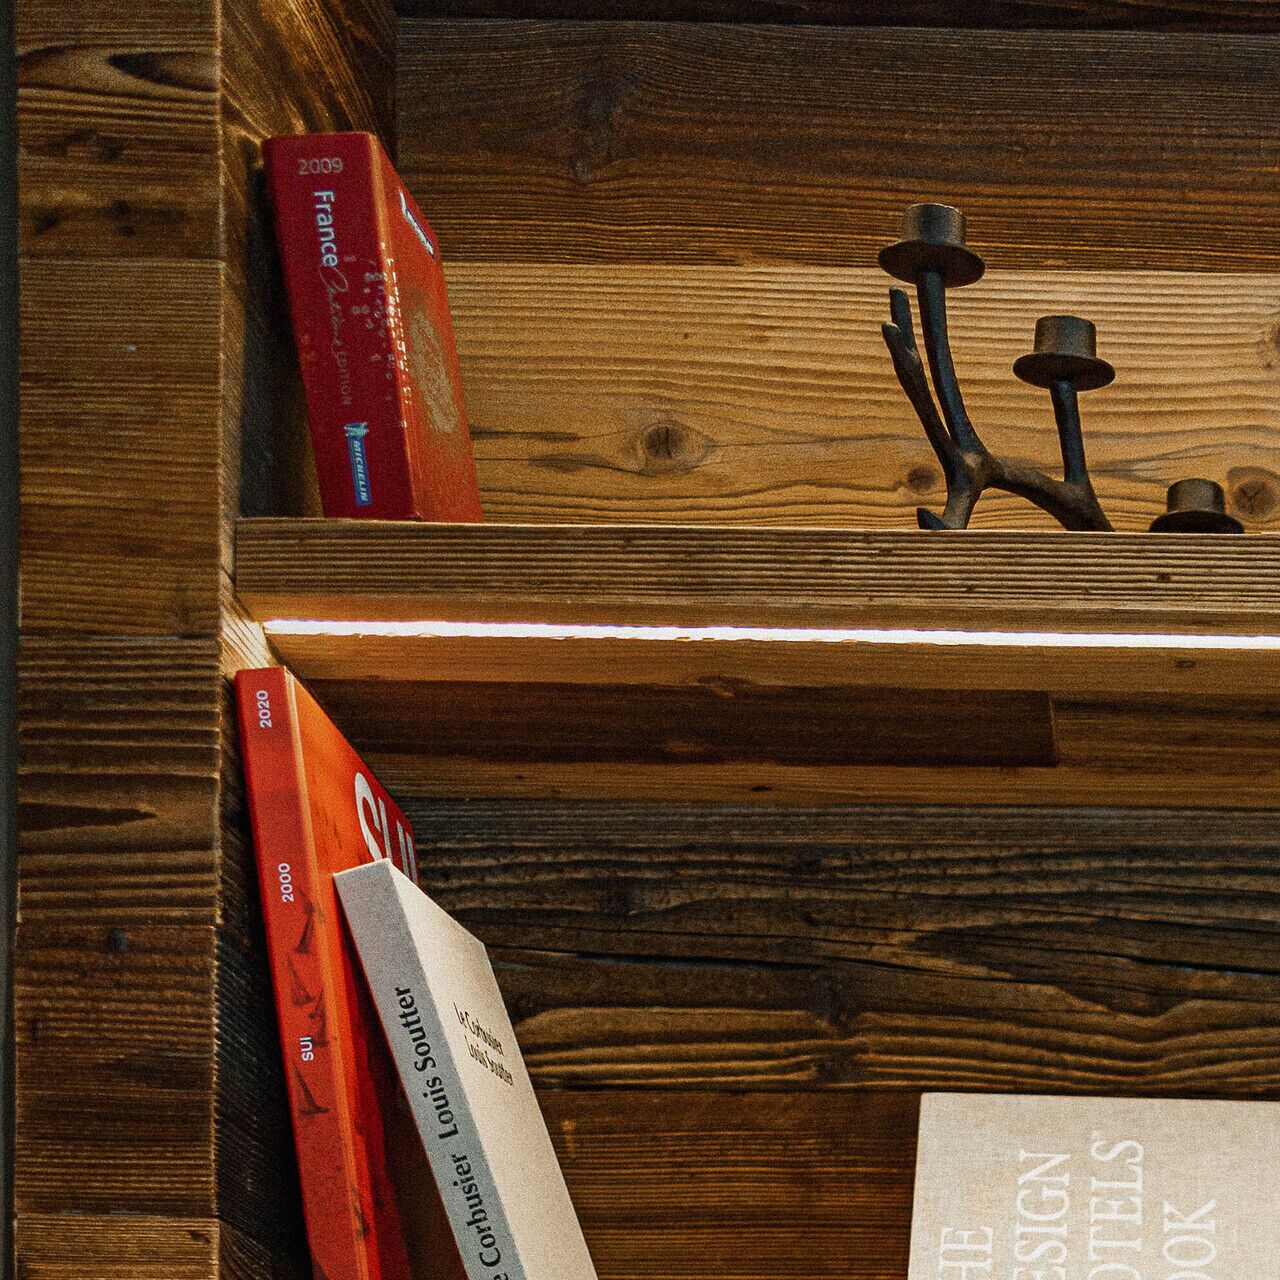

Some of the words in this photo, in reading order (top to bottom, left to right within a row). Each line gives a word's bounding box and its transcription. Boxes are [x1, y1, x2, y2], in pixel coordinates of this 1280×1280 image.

[298, 157, 343, 174] 2009
[313, 190, 338, 267] France
[256, 689, 272, 729] 2020
[277, 862, 294, 903] 2000
[300, 1036, 314, 1061] SUI
[394, 986, 437, 1073] Soutter
[454, 1002, 467, 1029] Le
[464, 1011, 504, 1056] Corbusier
[464, 1035, 488, 1069] Louis
[484, 1050, 515, 1086] Soutter
[423, 1076, 459, 1140] Louis
[451, 1153, 501, 1268] Corbusier
